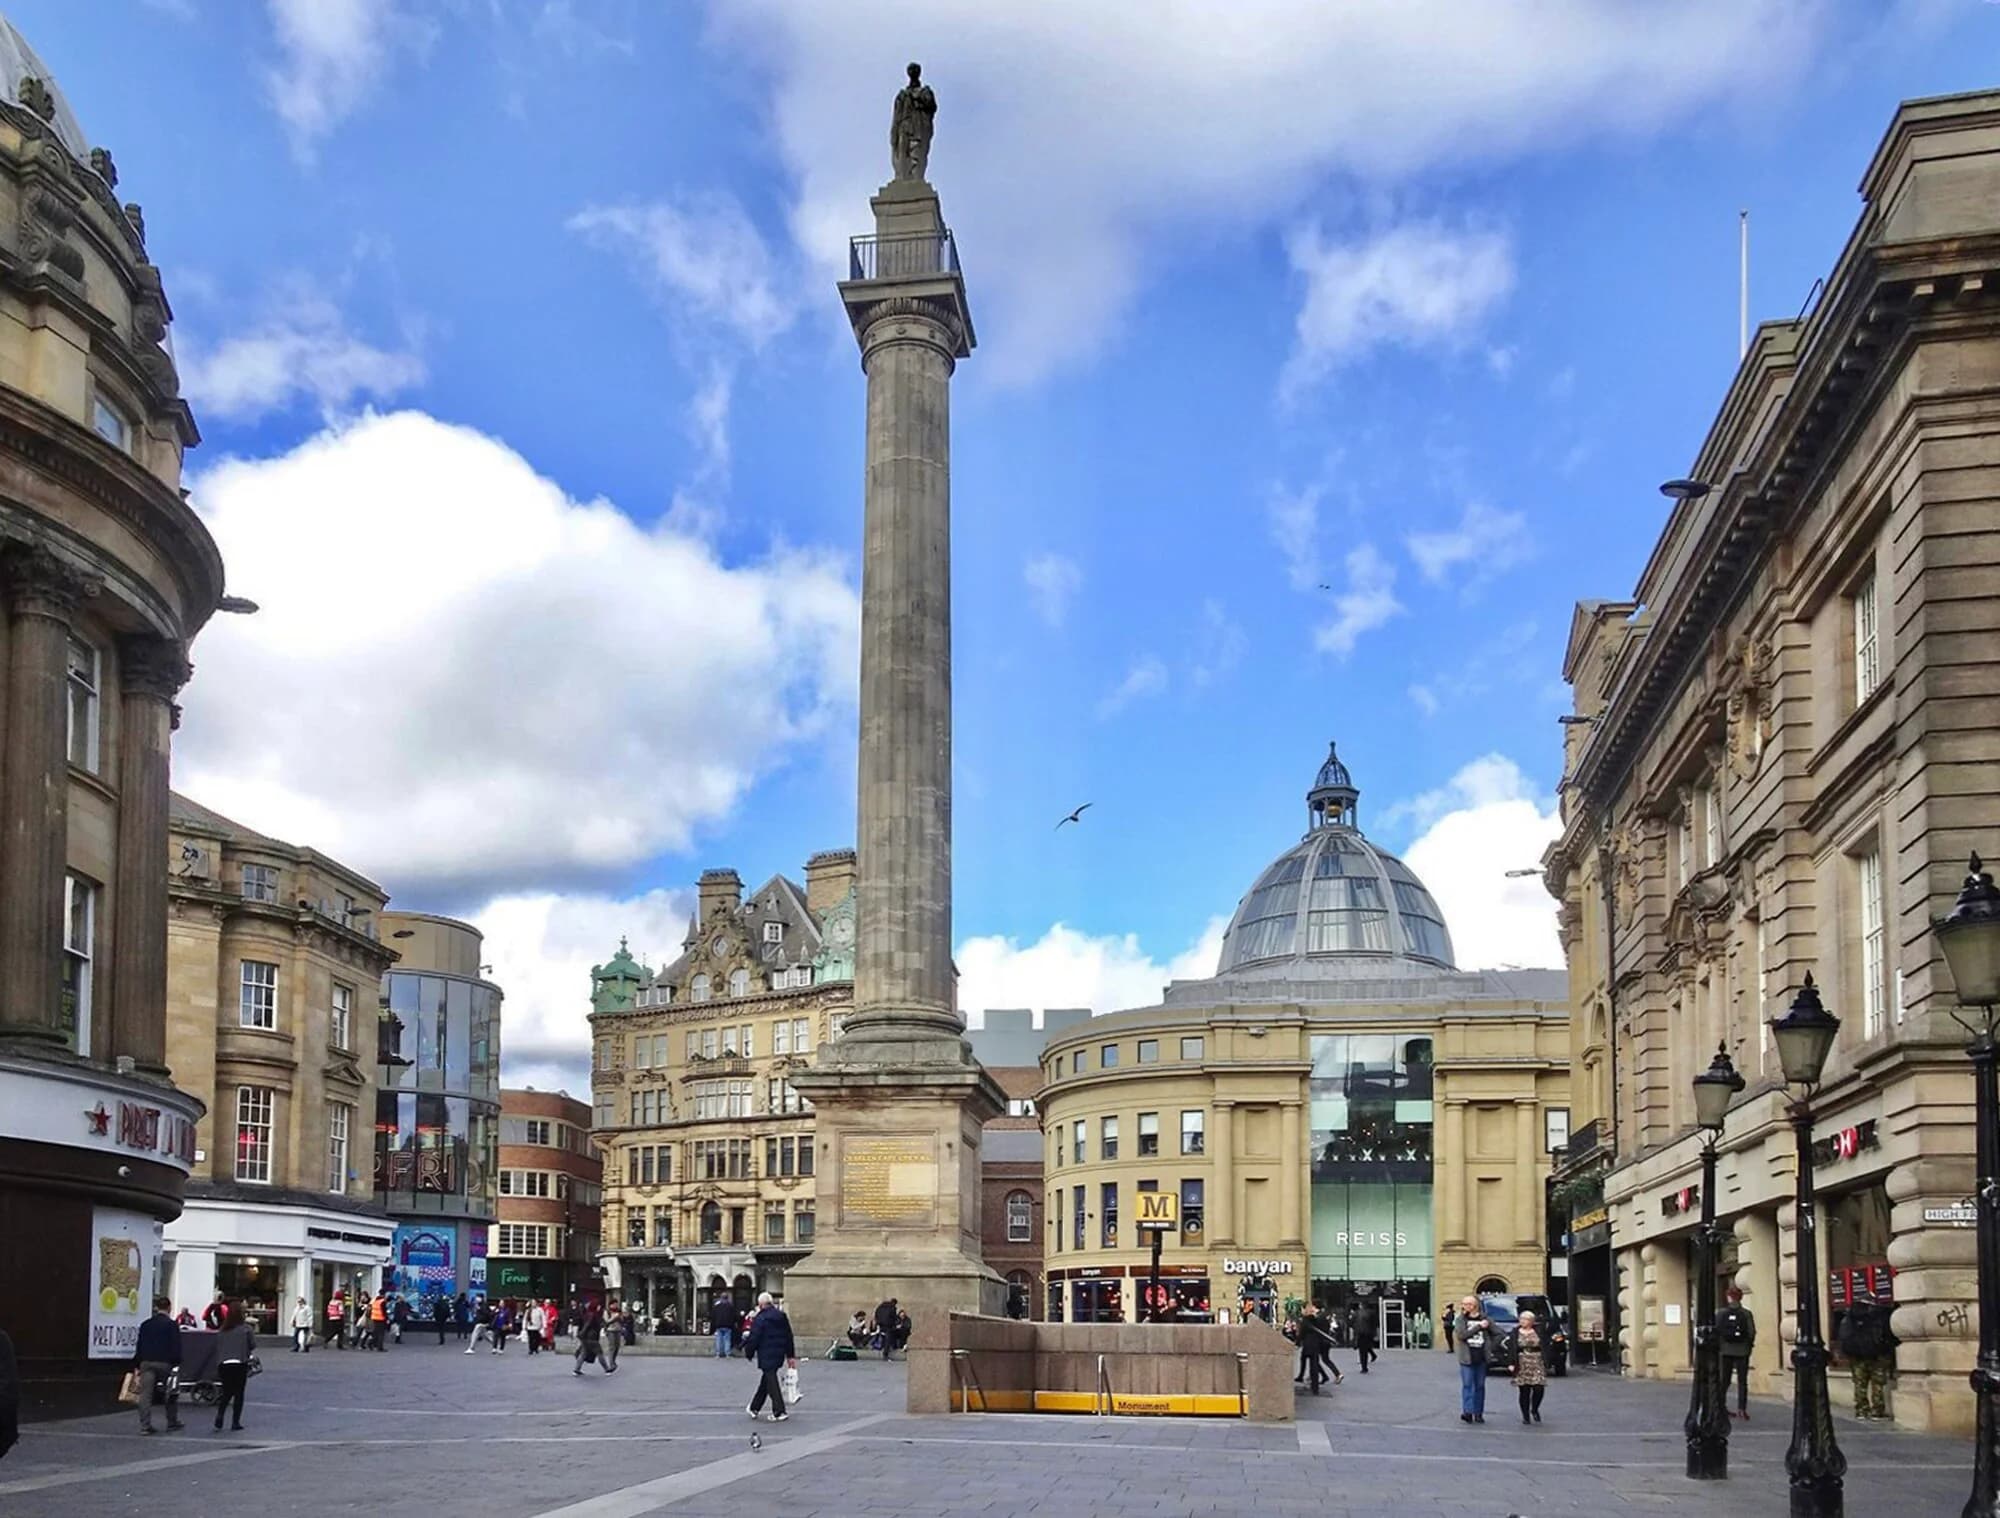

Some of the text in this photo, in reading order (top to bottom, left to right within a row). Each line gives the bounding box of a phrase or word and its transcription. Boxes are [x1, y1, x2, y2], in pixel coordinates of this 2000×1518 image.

[115, 1100, 160, 1152] PRET
[1142, 1196, 1169, 1218] M
[1928, 1210, 1959, 1218] HIGH
[1336, 1232, 1407, 1246] REISS
[1223, 1258, 1292, 1277] banyan
[93, 1325, 114, 1346] PRET
[1118, 1401, 1170, 1411] Monument
